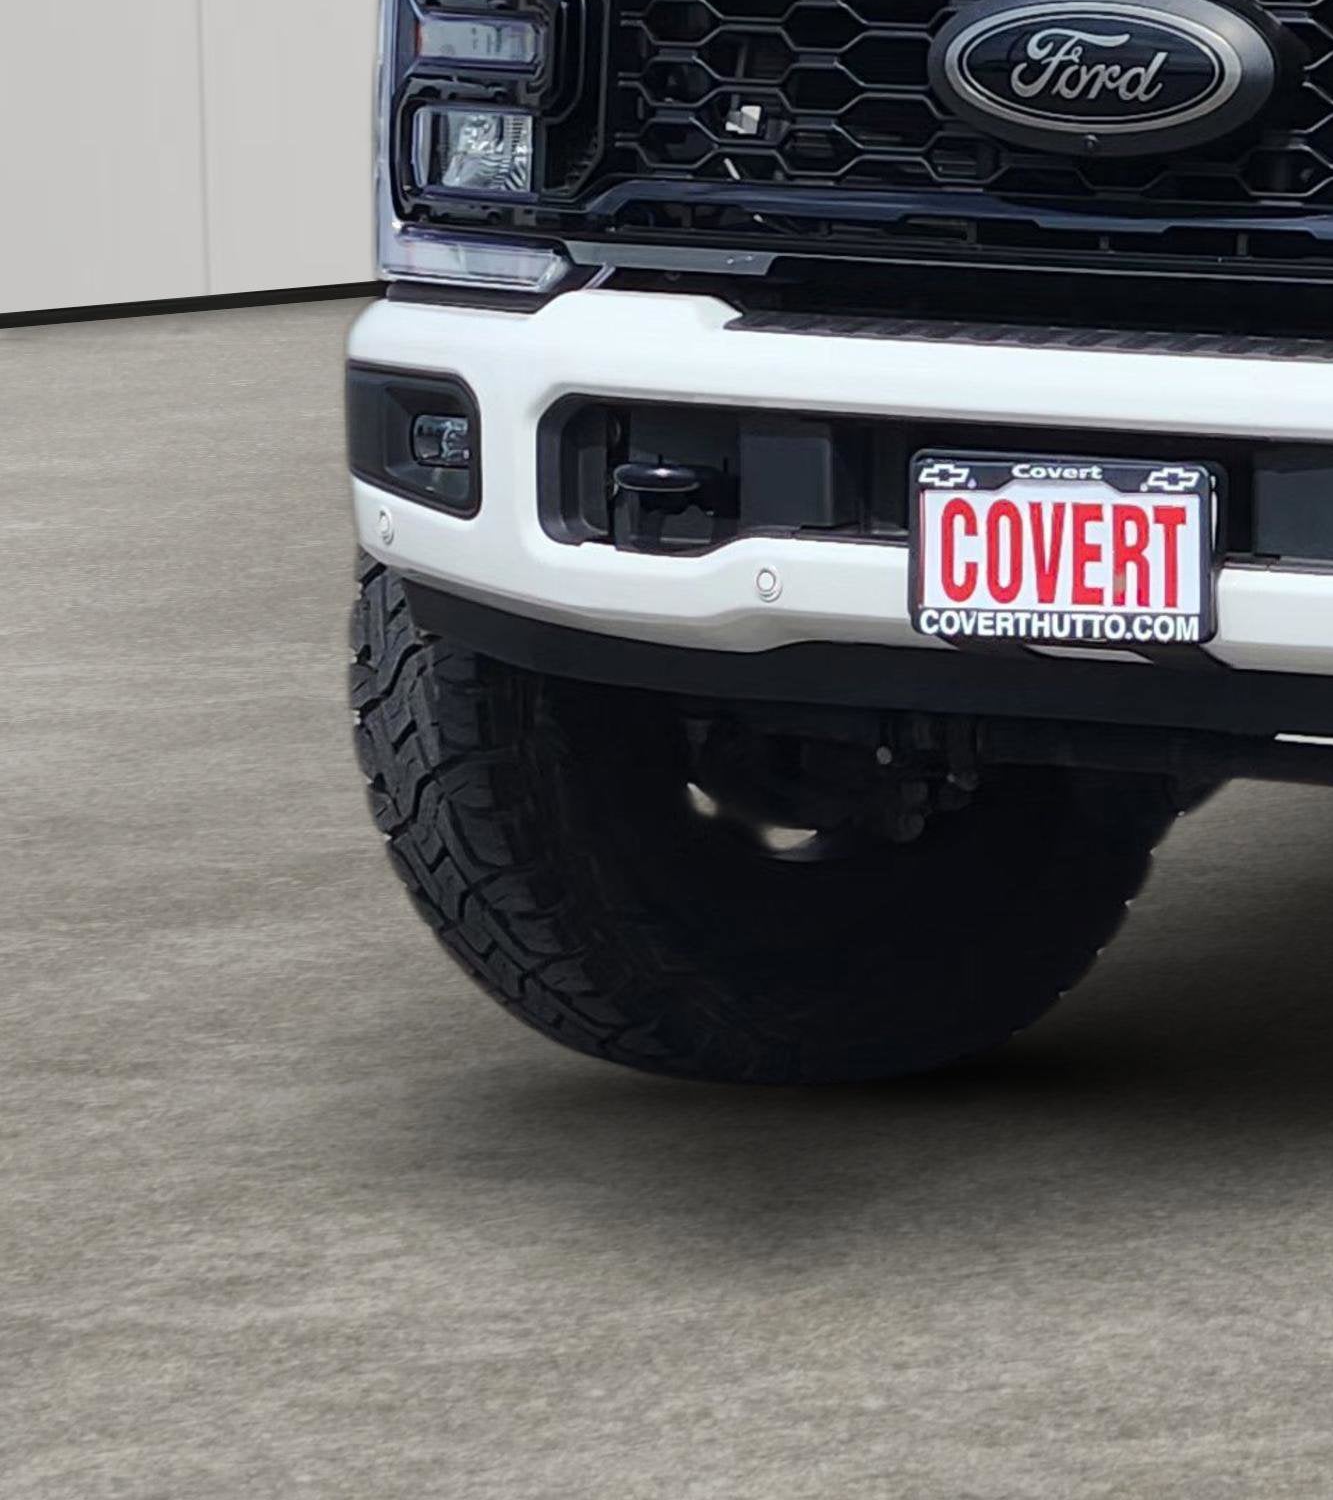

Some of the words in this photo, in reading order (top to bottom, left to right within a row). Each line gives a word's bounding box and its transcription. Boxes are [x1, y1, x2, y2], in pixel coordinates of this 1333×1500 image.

[1011, 28, 1168, 102] Ford
[1012, 464, 1103, 480] Covert
[941, 498, 1186, 608] COVERT
[919, 610, 1200, 643] COVERTHUTTO.COM
